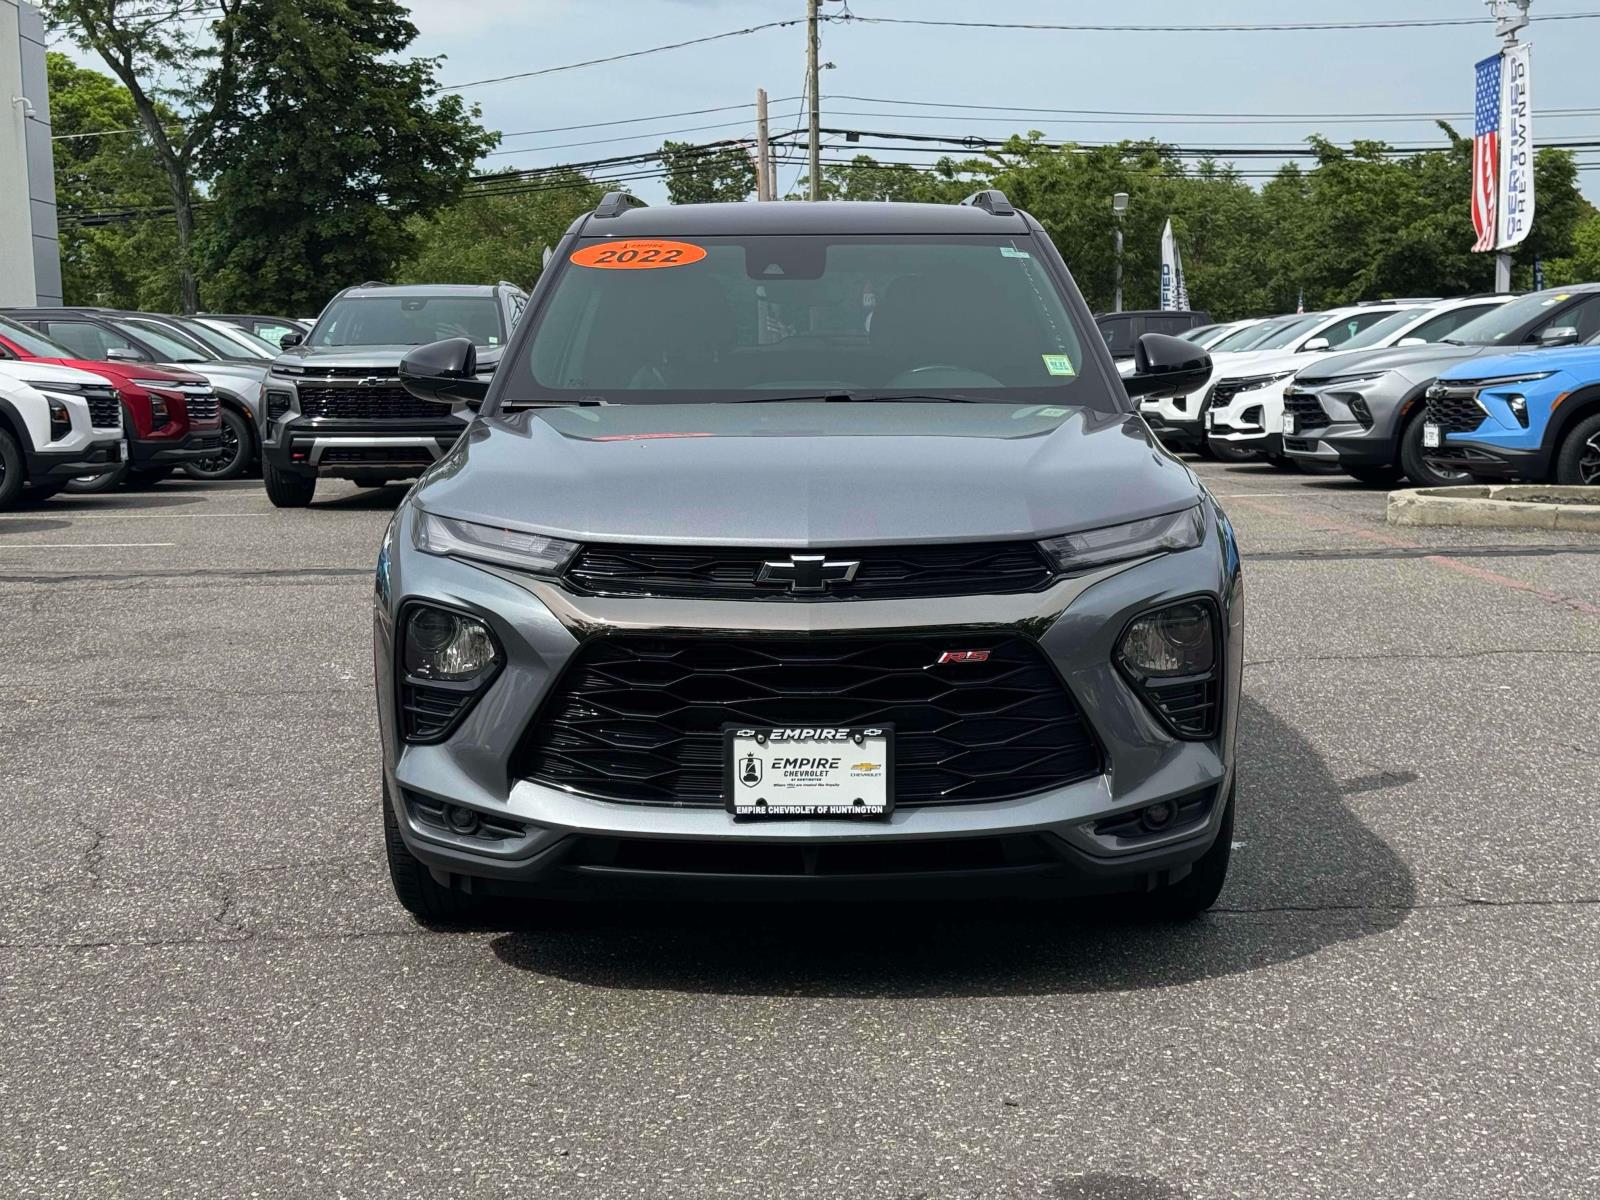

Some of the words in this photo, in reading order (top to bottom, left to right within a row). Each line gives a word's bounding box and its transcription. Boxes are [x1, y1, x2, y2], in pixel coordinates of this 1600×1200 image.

[1507, 57, 1520, 240] CERTIFIED
[1516, 62, 1527, 232] PRE-OWNED
[593, 249, 684, 264] 2022
[1162, 263, 1171, 311] IFIED
[937, 650, 990, 663] RS
[769, 728, 850, 740] EMPIRE
[771, 758, 841, 769] EMPIRE
[736, 806, 766, 814] EMPIRE
[768, 806, 815, 814] CHEVROLET
[817, 806, 828, 814] OF
[830, 806, 883, 814] HUNTINGTON
